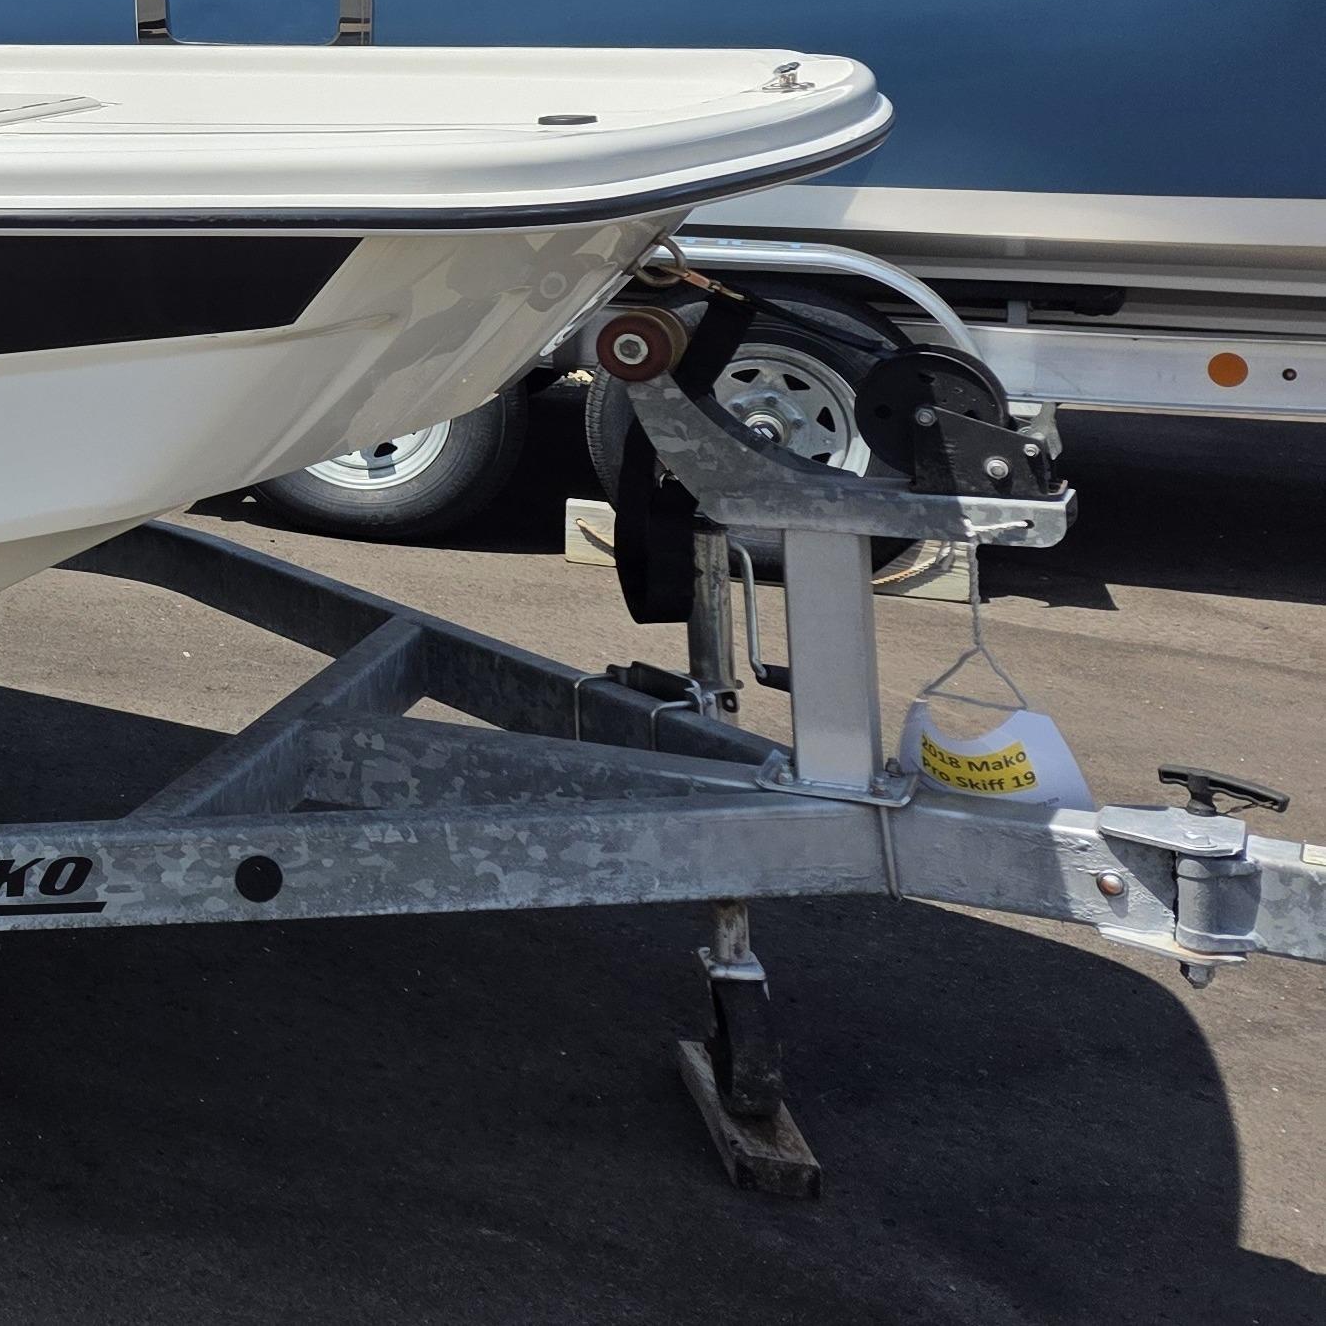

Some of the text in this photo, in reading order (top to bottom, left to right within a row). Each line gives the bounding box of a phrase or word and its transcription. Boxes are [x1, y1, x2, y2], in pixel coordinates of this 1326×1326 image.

[921, 731, 1028, 773] 2018 Mako
[922, 755, 1038, 792] Pro Skiff 19
